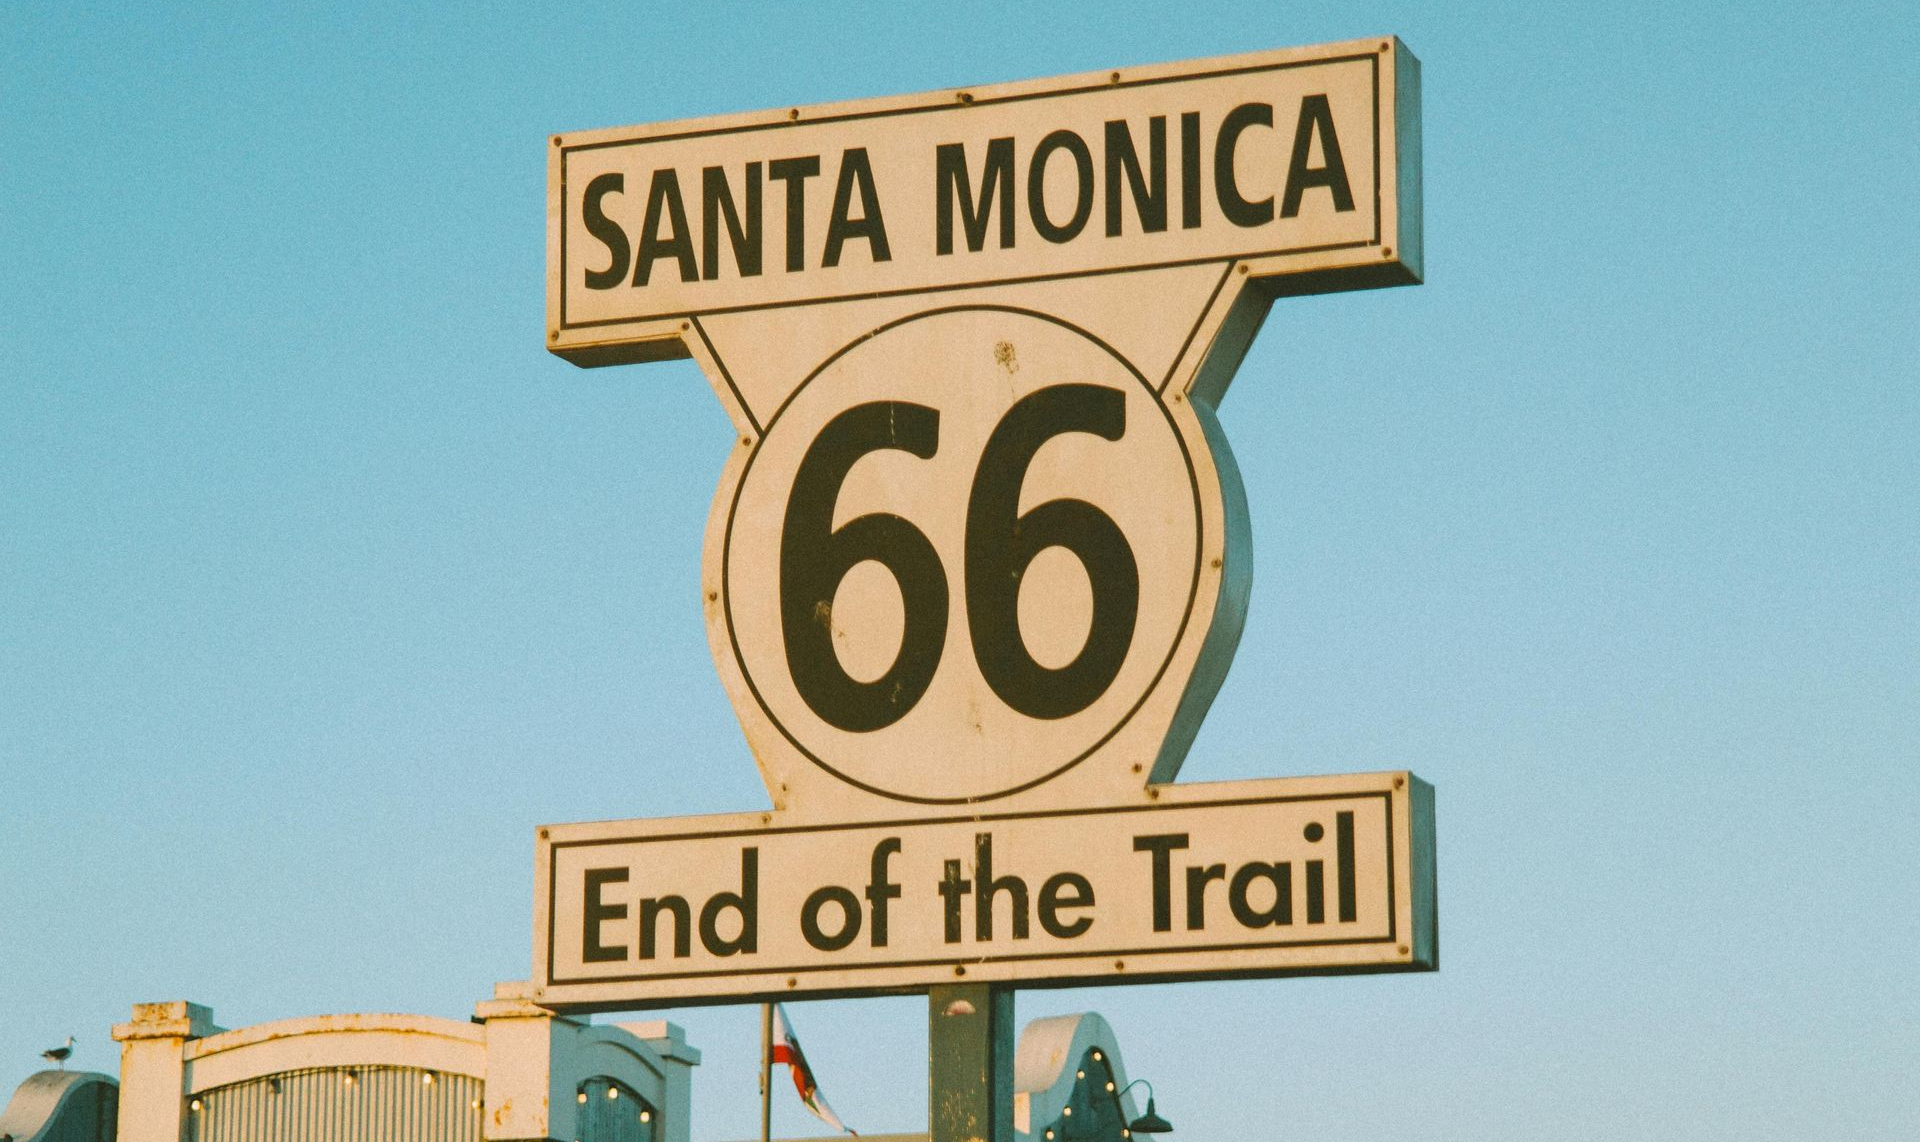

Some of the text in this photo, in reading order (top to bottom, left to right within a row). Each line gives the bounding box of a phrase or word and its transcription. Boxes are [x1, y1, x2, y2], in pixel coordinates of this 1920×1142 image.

[583, 93, 1356, 291] SANTA MONICA
[779, 382, 1140, 734] 66
[583, 810, 1357, 964] End of the Trail
